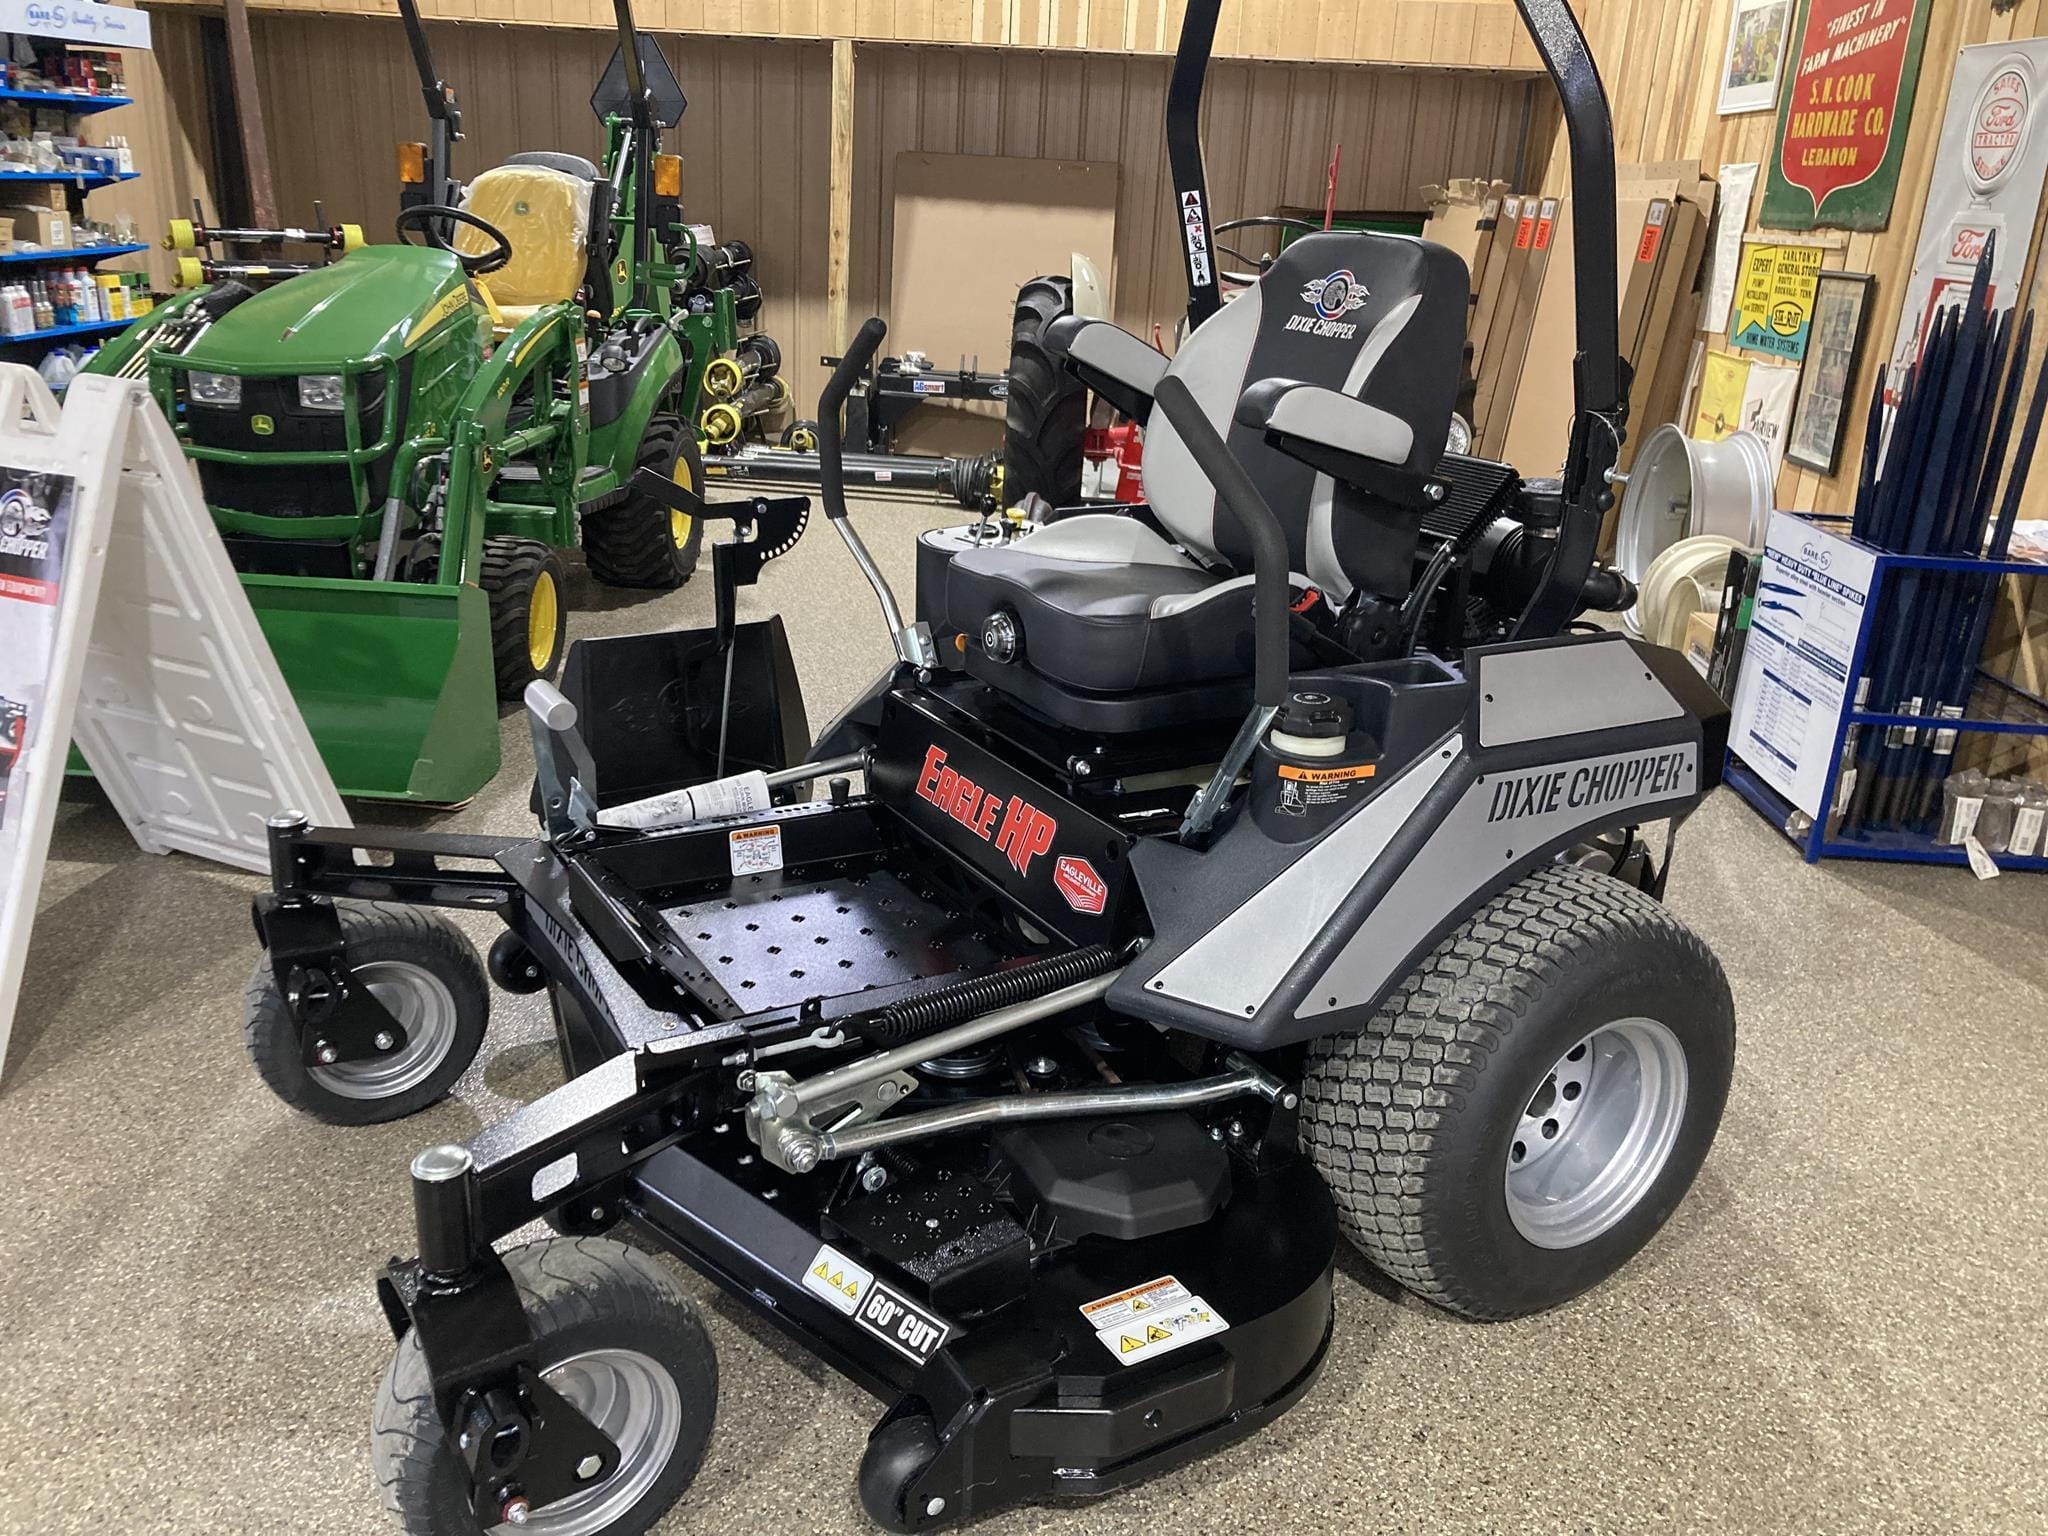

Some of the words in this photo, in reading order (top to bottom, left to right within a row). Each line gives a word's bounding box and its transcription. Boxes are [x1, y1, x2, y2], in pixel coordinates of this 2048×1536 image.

[1801, 48, 1830, 77] FARM
[1835, 73, 1876, 103] COOK
[1993, 77, 2021, 94] SALES
[1791, 108, 1858, 138] HARDWARE
[1864, 107, 1884, 136] CO.
[1986, 105, 2017, 127] Ford
[1801, 147, 1858, 166] LEBANON
[1517, 221, 1531, 248] FRAGILE
[1535, 222, 1550, 249] FRAGILE
[1640, 229, 1657, 261] FRAGILE
[1752, 257, 1773, 273] EXPERT
[1777, 262, 1800, 276] GENERAL
[1783, 250, 1818, 264] CARLTON'S
[1285, 315, 1317, 334] DIXIE
[1313, 319, 1357, 340] CHOPPER
[914, 382, 944, 392] AGsmart
[1311, 769, 1357, 780] WARNING
[1487, 771, 1547, 823] DIXIE
[1567, 752, 1685, 808] CHOPPER
[915, 743, 1003, 842] EAGLE
[994, 794, 1057, 879] HP
[744, 829, 776, 840] WARNING
[1060, 859, 1104, 896] EAGLEVILLE
[866, 1294, 905, 1327] 60"
[897, 1314, 940, 1354] CUT
